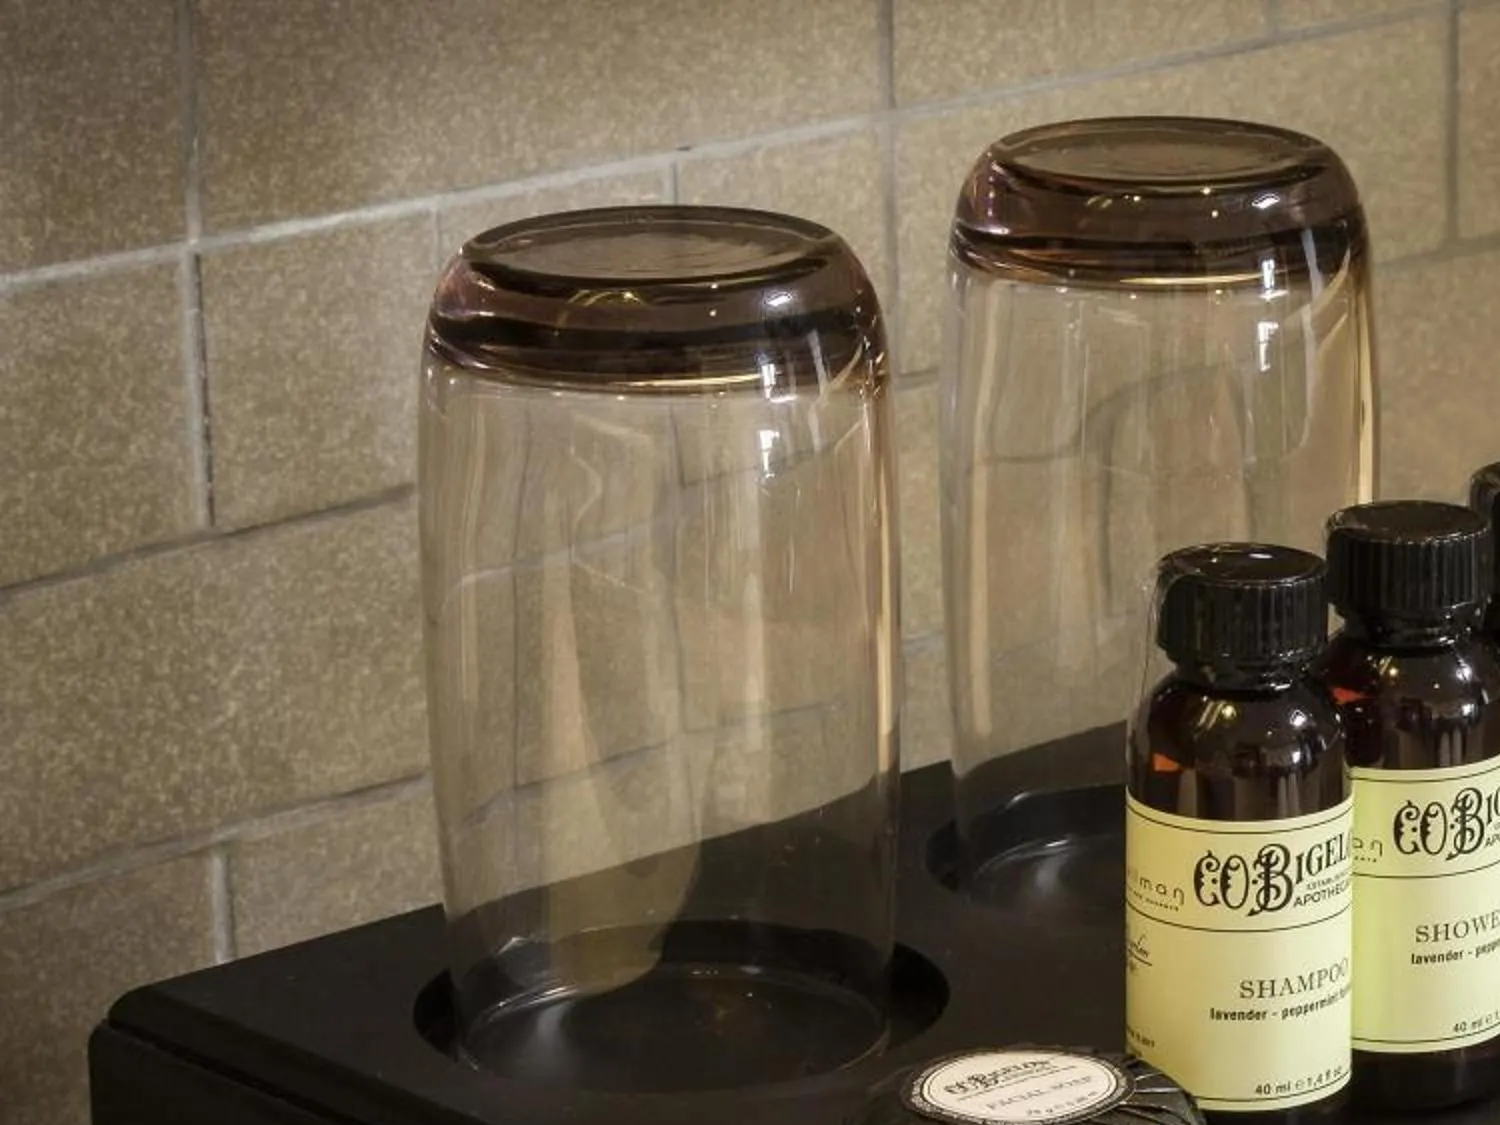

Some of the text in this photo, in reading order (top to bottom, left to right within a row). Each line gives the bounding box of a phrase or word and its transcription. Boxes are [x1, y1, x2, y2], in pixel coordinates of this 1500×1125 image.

[1411, 949, 1464, 965] lavender
[1210, 1008, 1268, 1021] lavender
[1281, 991, 1340, 1020] peppermint
[1453, 1020, 1468, 1033] 40
[1255, 1083, 1271, 1095] 40
[1275, 1081, 1291, 1094] ml
